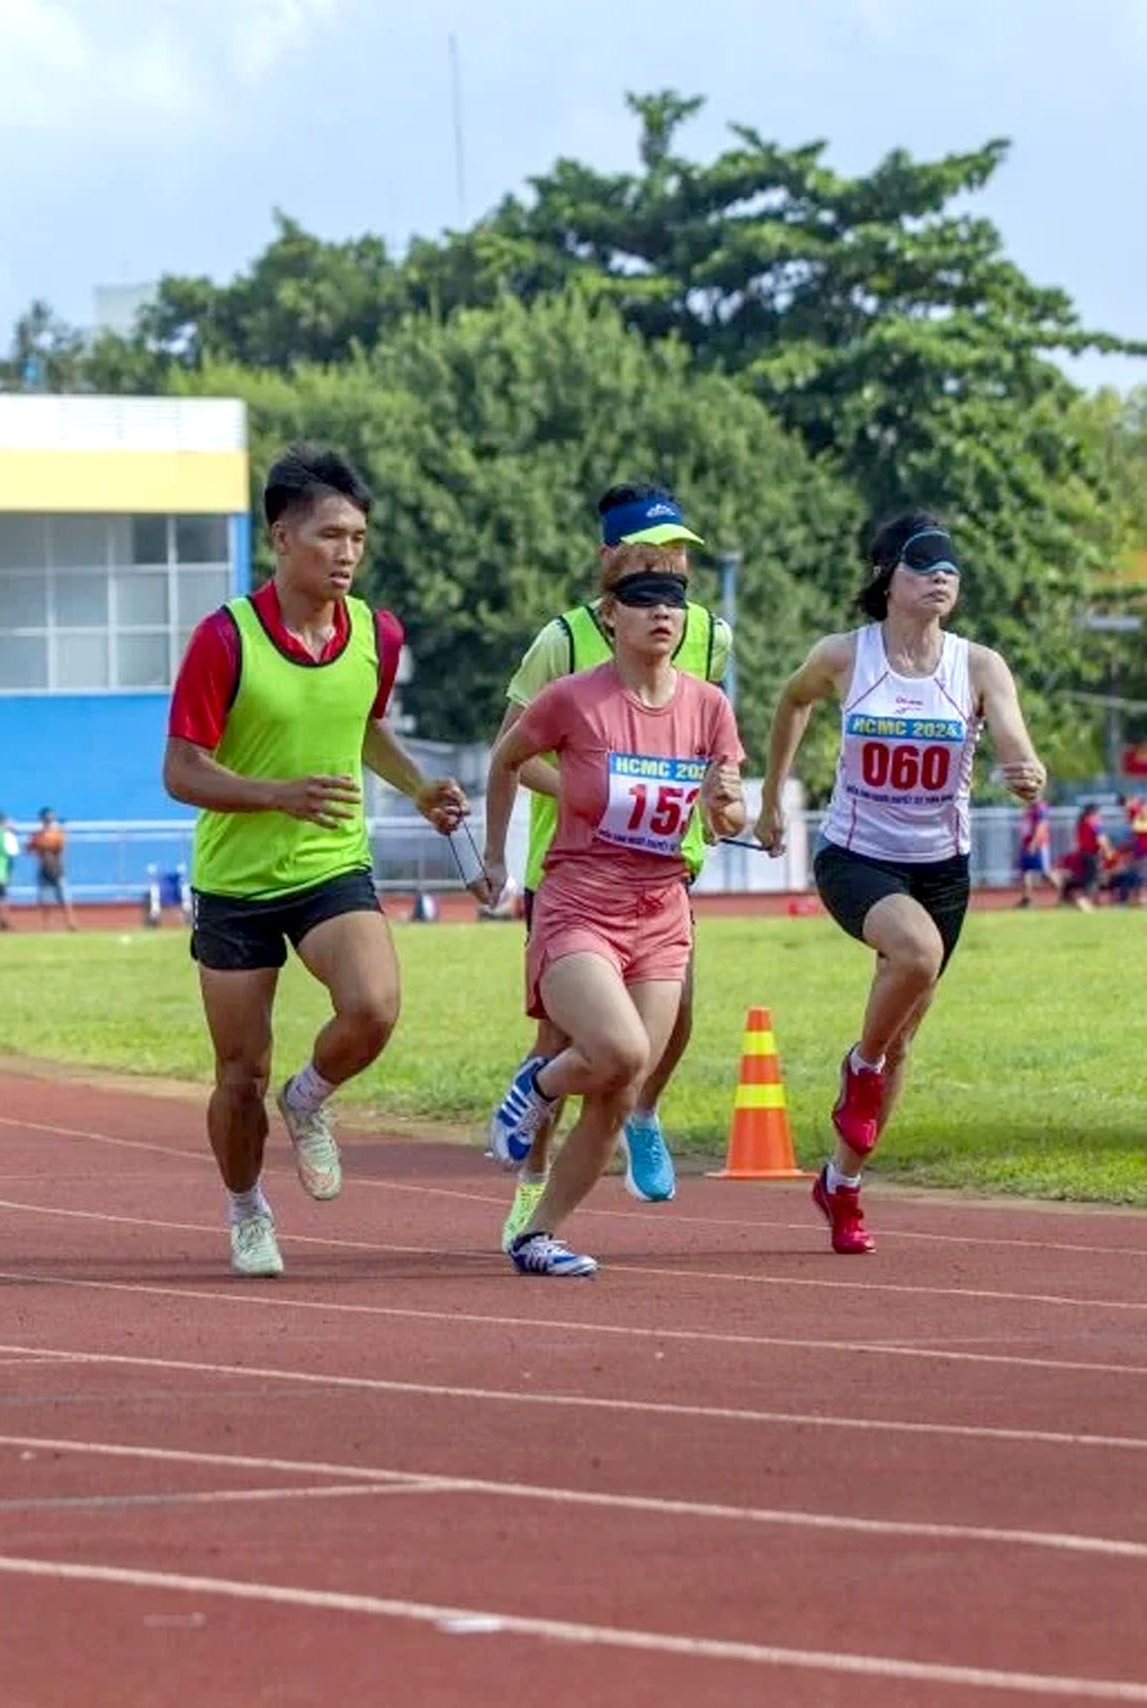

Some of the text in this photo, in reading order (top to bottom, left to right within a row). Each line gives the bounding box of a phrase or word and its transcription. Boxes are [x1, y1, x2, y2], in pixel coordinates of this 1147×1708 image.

[853, 719, 959, 738] HCMC 2024
[615, 757, 670, 777] HCMC
[863, 741, 950, 791] 060
